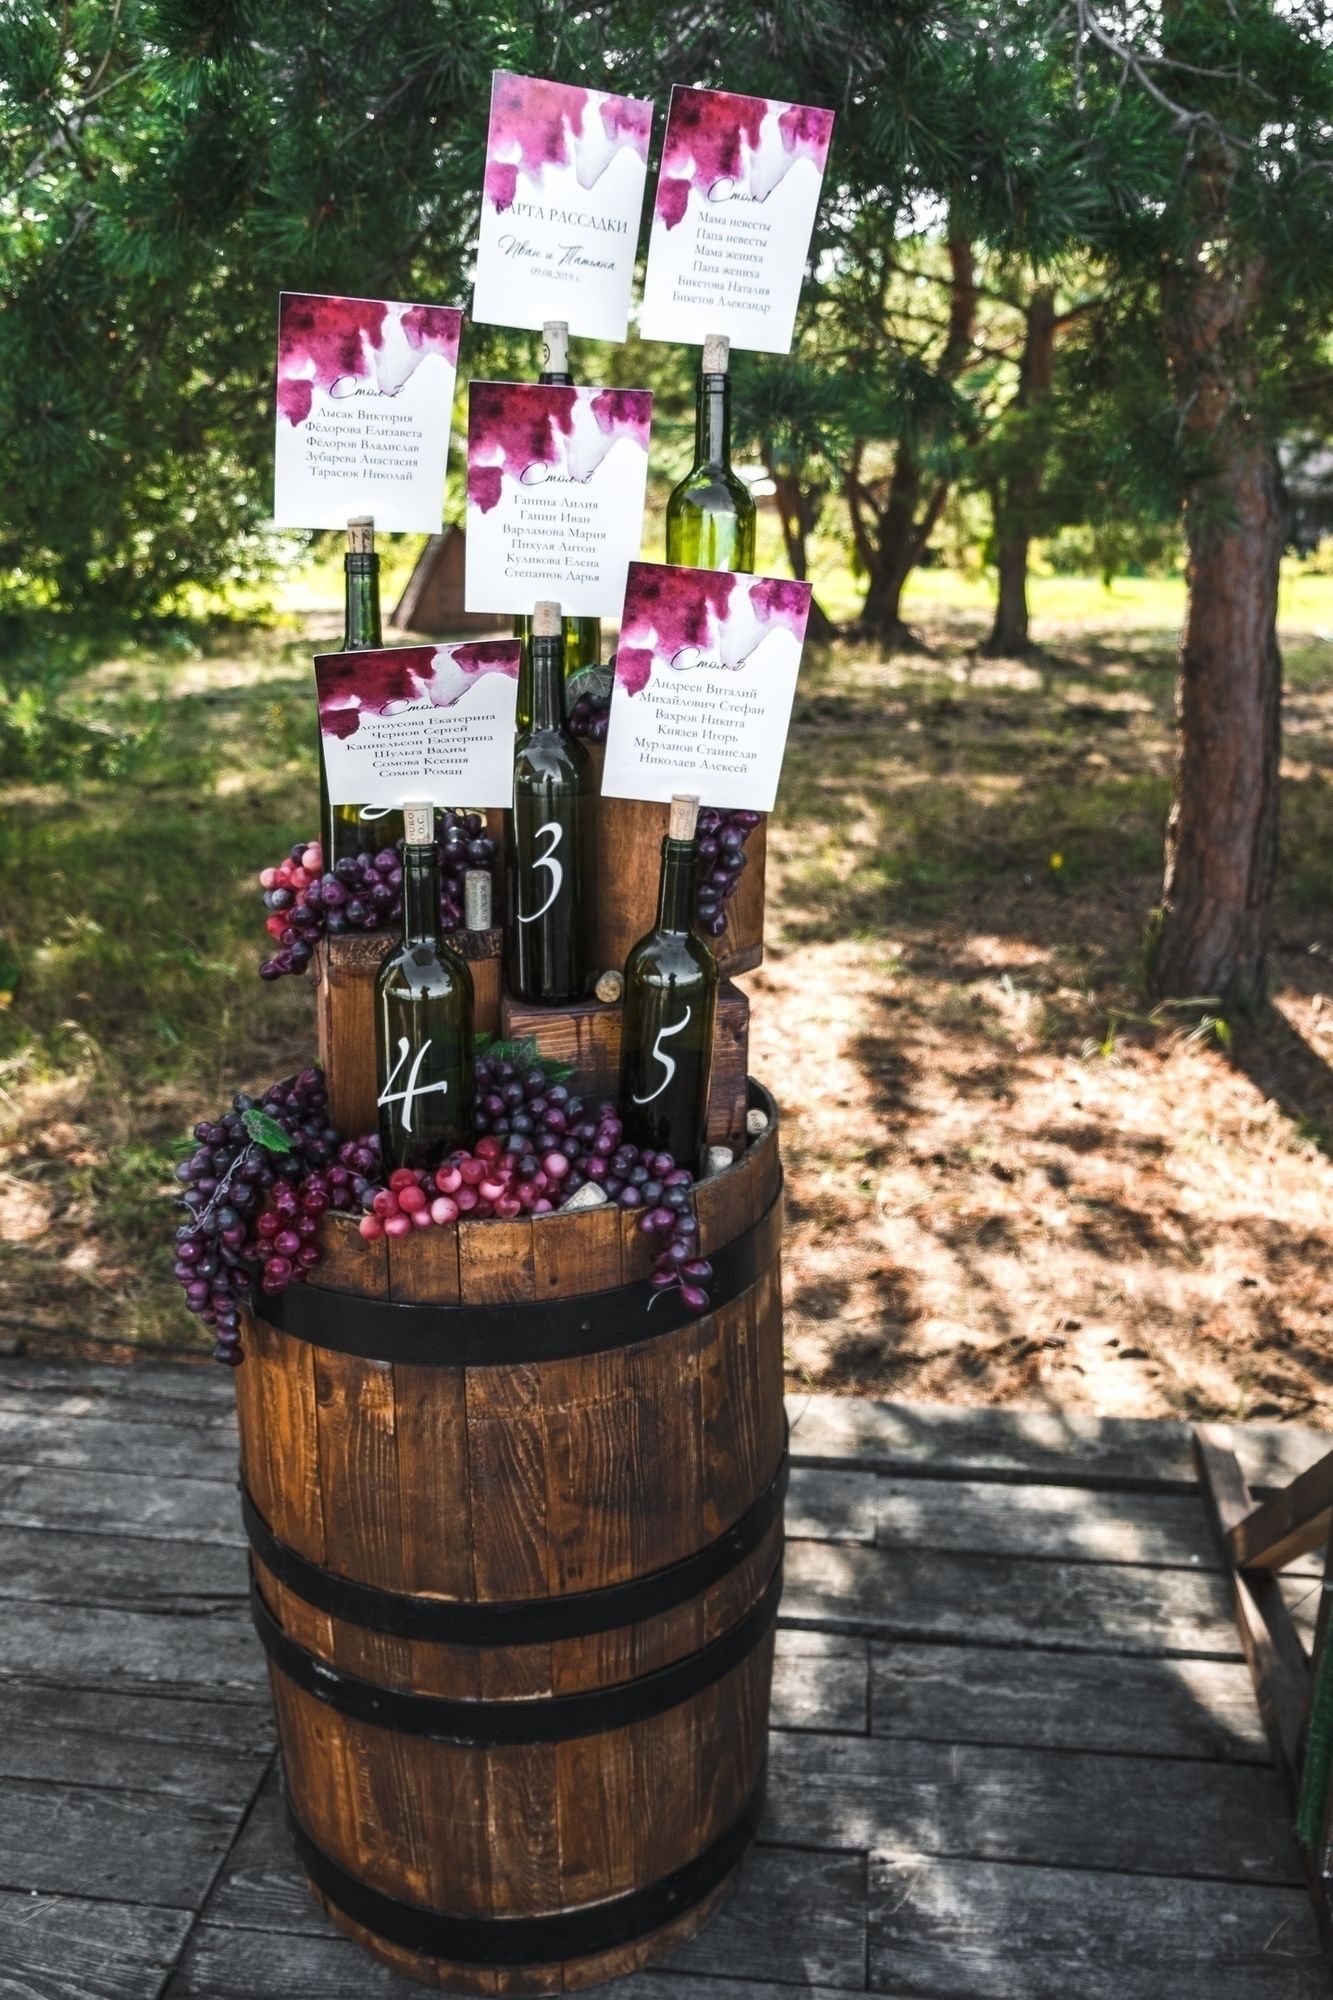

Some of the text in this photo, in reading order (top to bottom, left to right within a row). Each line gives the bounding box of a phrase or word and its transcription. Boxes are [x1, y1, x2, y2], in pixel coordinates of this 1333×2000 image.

[707, 176, 757, 203] Стол
[550, 208, 628, 234] РАССАДКИ
[698, 211, 772, 231] Мама невесты
[696, 228, 768, 248] Папа невесты
[498, 234, 617, 271] Иван и Татьяна
[694, 244, 764, 263] Мама жениха
[693, 260, 760, 279] Папа жениха
[678, 275, 770, 296] Бикетова Наталия
[672, 290, 771, 316] Бикетов Александр
[330, 375, 405, 399] Стол 2
[318, 407, 413, 424] Лысак Виктория
[304, 421, 422, 438] Фёдорова Елизавета
[306, 436, 420, 452] Фёдоров Владислав
[305, 451, 418, 467] Зубарева Анастасия
[309, 466, 413, 480] Тарасюк Николай
[520, 462, 575, 486] Стол
[514, 494, 599, 510] Ганина Лилия
[520, 510, 591, 524] Ганин Иван
[503, 523, 606, 542] Варламова Мария
[559, 542, 596, 554] Антон
[506, 553, 600, 568] Куликова Елена
[504, 567, 600, 584] Степанюк Дарья
[670, 646, 727, 671] Стол
[652, 678, 758, 699] Андреев Виталий
[380, 698, 440, 716] Стол
[639, 692, 765, 716] Михайлович Стефан
[360, 714, 496, 731] лотоусова Екатерина
[655, 708, 745, 728] Вахров Никита
[372, 725, 468, 740] Чернов Сергей
[428, 735, 494, 746] Екатерина
[657, 724, 739, 744] Князев Игорь
[374, 750, 422, 759] Шульга
[696, 744, 758, 760] Станислав
[372, 757, 469, 768] Сомова Ксения
[640, 752, 748, 774] Николаев Алексей
[379, 768, 463, 778] Сомов Роман
[517, 821, 564, 923] 3
[632, 1005, 691, 1104] 5
[377, 1037, 448, 1133] 4
